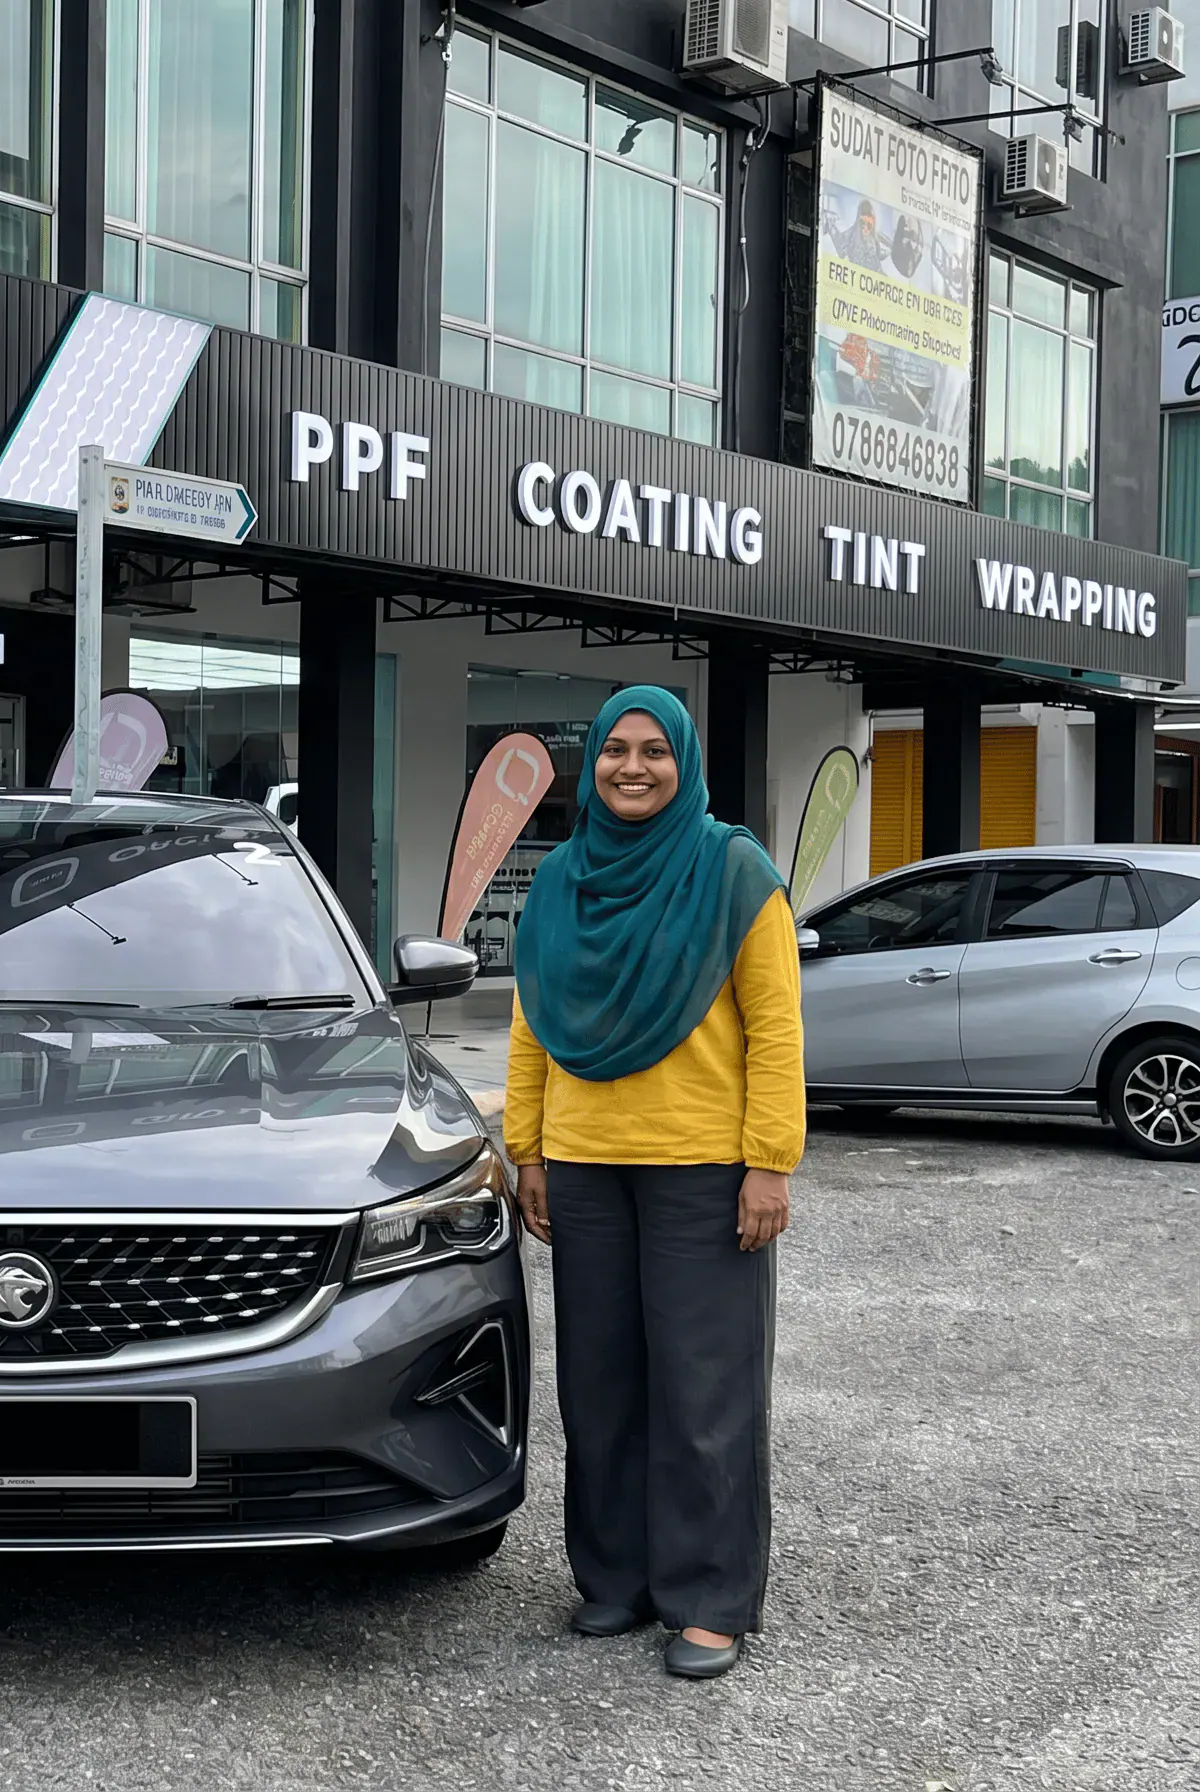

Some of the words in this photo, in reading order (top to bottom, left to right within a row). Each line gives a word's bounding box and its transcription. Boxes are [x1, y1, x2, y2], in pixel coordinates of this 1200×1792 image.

[830, 107, 883, 166] SUDAT
[887, 133, 927, 186] FOTO
[832, 412, 959, 489] 0786846838
[291, 411, 430, 500] PPF
[517, 461, 763, 565] COATING
[824, 525, 926, 594] TINT
[976, 558, 1157, 638] WRAPPING
